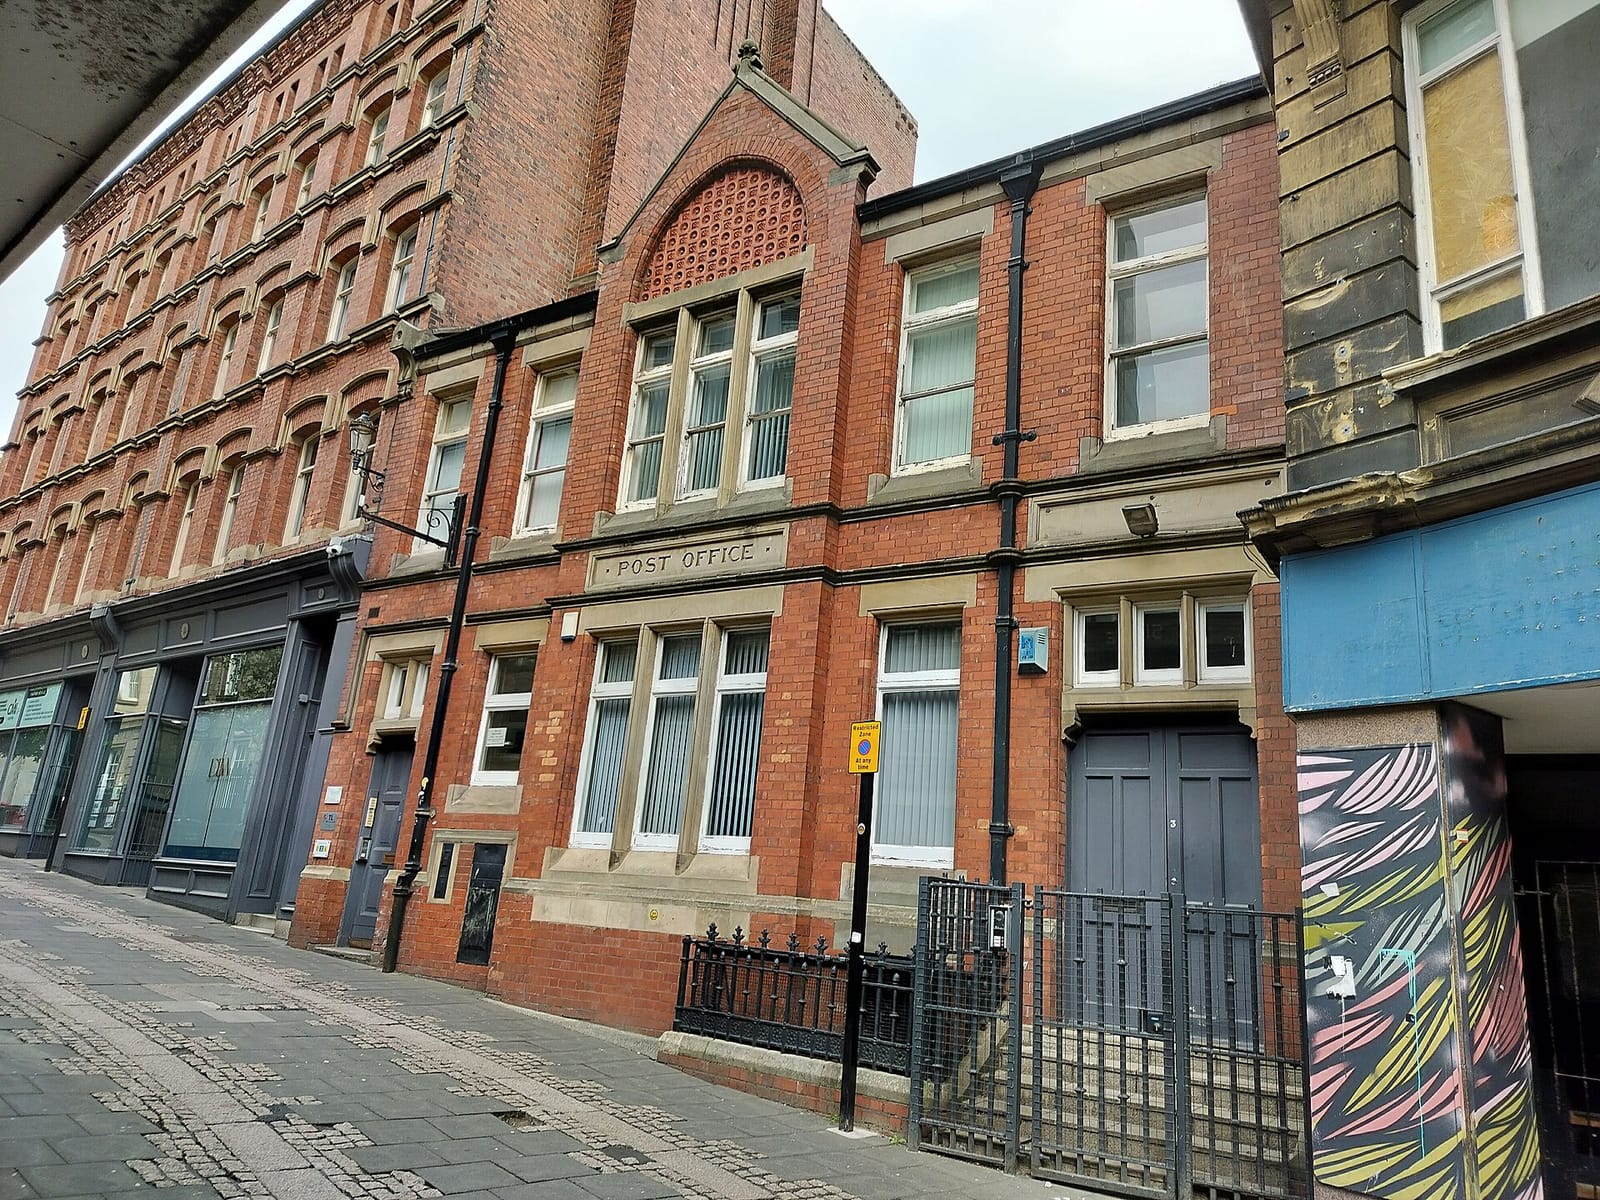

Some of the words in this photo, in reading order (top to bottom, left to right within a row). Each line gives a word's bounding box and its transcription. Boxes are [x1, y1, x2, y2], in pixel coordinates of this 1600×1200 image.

[617, 555, 671, 577] POST
[682, 543, 754, 568] OFFICE
[1170, 819, 1177, 828] 3
